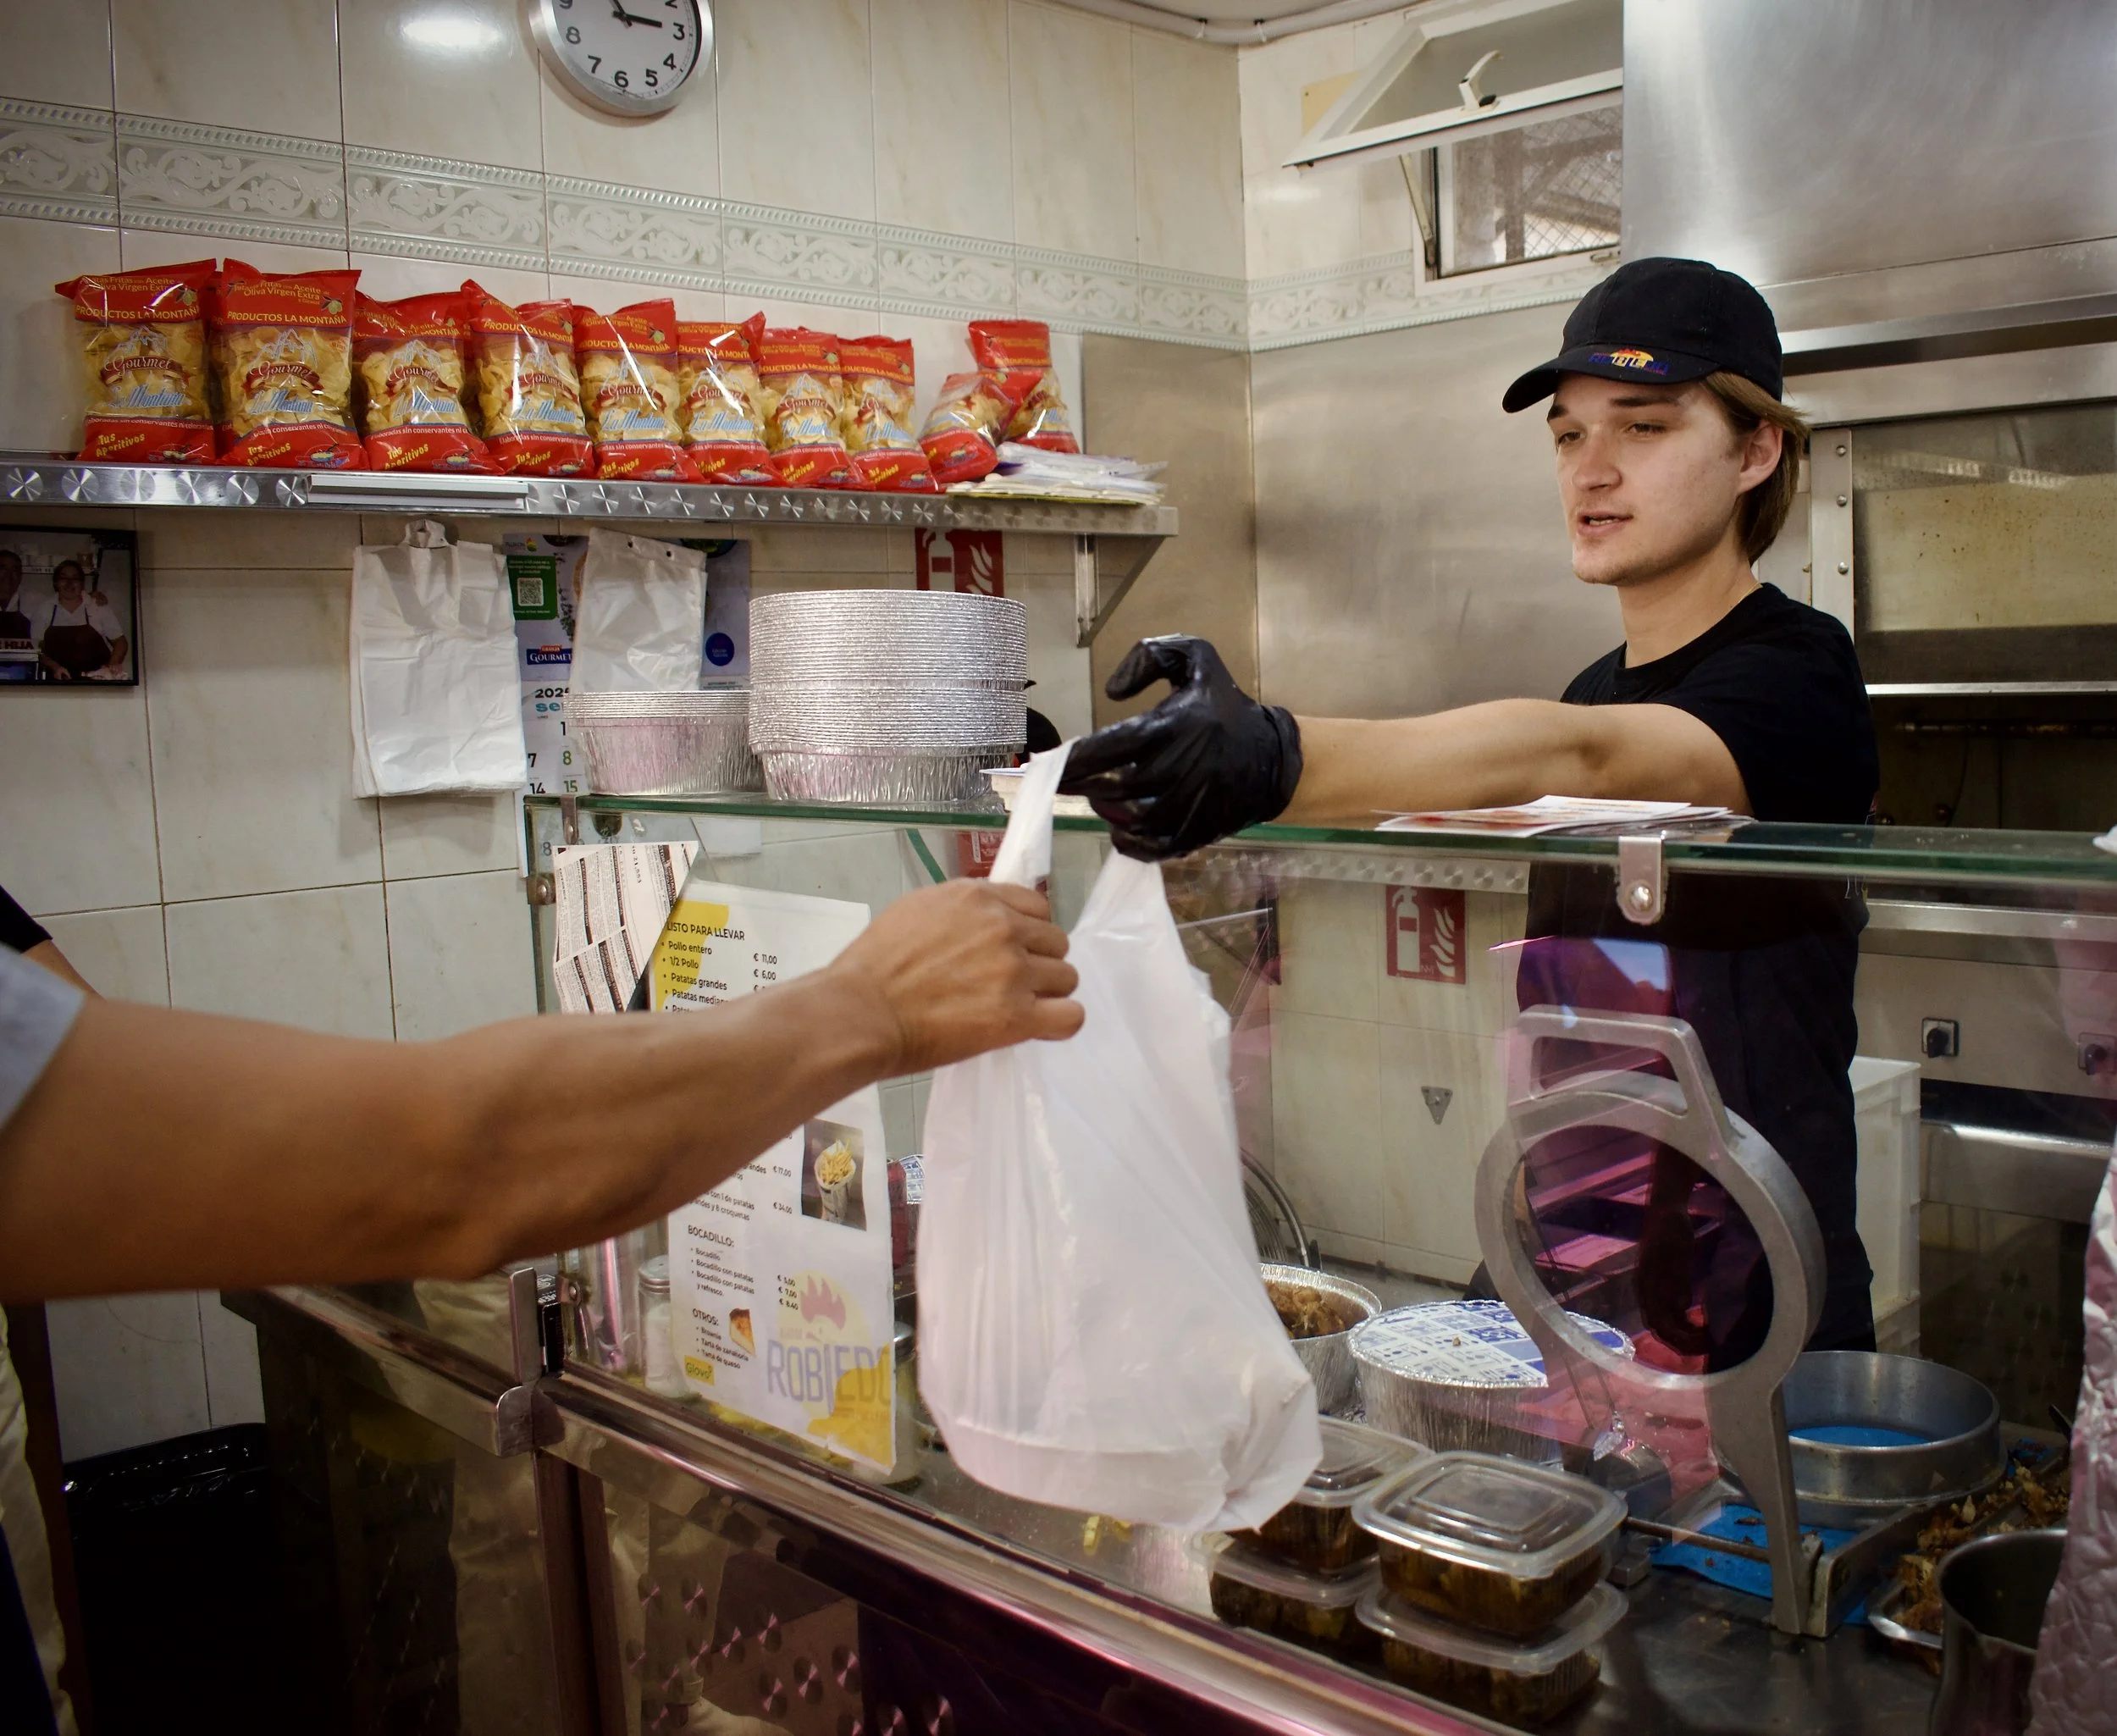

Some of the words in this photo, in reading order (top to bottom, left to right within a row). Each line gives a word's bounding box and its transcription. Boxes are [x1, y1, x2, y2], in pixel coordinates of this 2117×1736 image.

[566, 26, 581, 44] 8
[672, 22, 684, 41] 3
[588, 54, 601, 74] 7
[663, 53, 677, 70] 4
[614, 70, 628, 88] 6
[645, 69, 658, 87] 5
[243, 287, 266, 296] Oliva
[268, 287, 296, 296] Virgen
[298, 290, 320, 300] Extra
[260, 279, 283, 288] Fritas
[293, 284, 321, 293] Aceite
[75, 305, 135, 319] PRODUCTOS
[138, 311, 150, 319] LA
[227, 311, 282, 322] PRODUCTOS
[285, 314, 297, 323] LA
[299, 314, 347, 325] MONTAÑA
[103, 356, 170, 374] Gourmet
[250, 361, 313, 380] Gourmet
[130, 418, 178, 428] conservantes
[272, 424, 317, 434] conservantes
[96, 434, 146, 458] Aperitivos
[98, 433, 116, 445] Tus
[248, 445, 263, 456] Tus
[387, 446, 403, 460] Tus
[516, 451, 531, 464] Tus
[602, 462, 616, 473] Tus
[529, 653, 572, 663] GOURMET
[528, 753, 537, 767] 7
[563, 750, 572, 766] 8
[529, 782, 546, 794] 14
[563, 780, 578, 793] 15
[666, 922, 688, 933] LISTO
[690, 924, 713, 936] PARA
[714, 927, 745, 941] LLEVAR
[669, 941, 687, 951] Pollo
[688, 944, 712, 955] entero
[754, 953, 759, 962] €
[761, 954, 777, 965] 11,00
[670, 956, 680, 967] 1/2
[682, 958, 699, 969] Pollo
[754, 969, 759, 977] €
[762, 970, 777, 981] 6,00
[672, 972, 698, 985] Patatas
[699, 978, 727, 991] grandes
[672, 988, 698, 1002] Patatas
[732, 1197, 755, 1210] patatas
[688, 1225, 735, 1247] BOCADILLO:
[695, 1247, 721, 1261] Bocadillo
[696, 1259, 721, 1272] Bocadillo
[722, 1267, 733, 1275] con
[733, 1271, 754, 1283] patatas
[696, 1270, 721, 1284] Bocadillo
[722, 1279, 733, 1287] con
[733, 1282, 754, 1294] patatas
[692, 1308, 719, 1326] OTROS:
